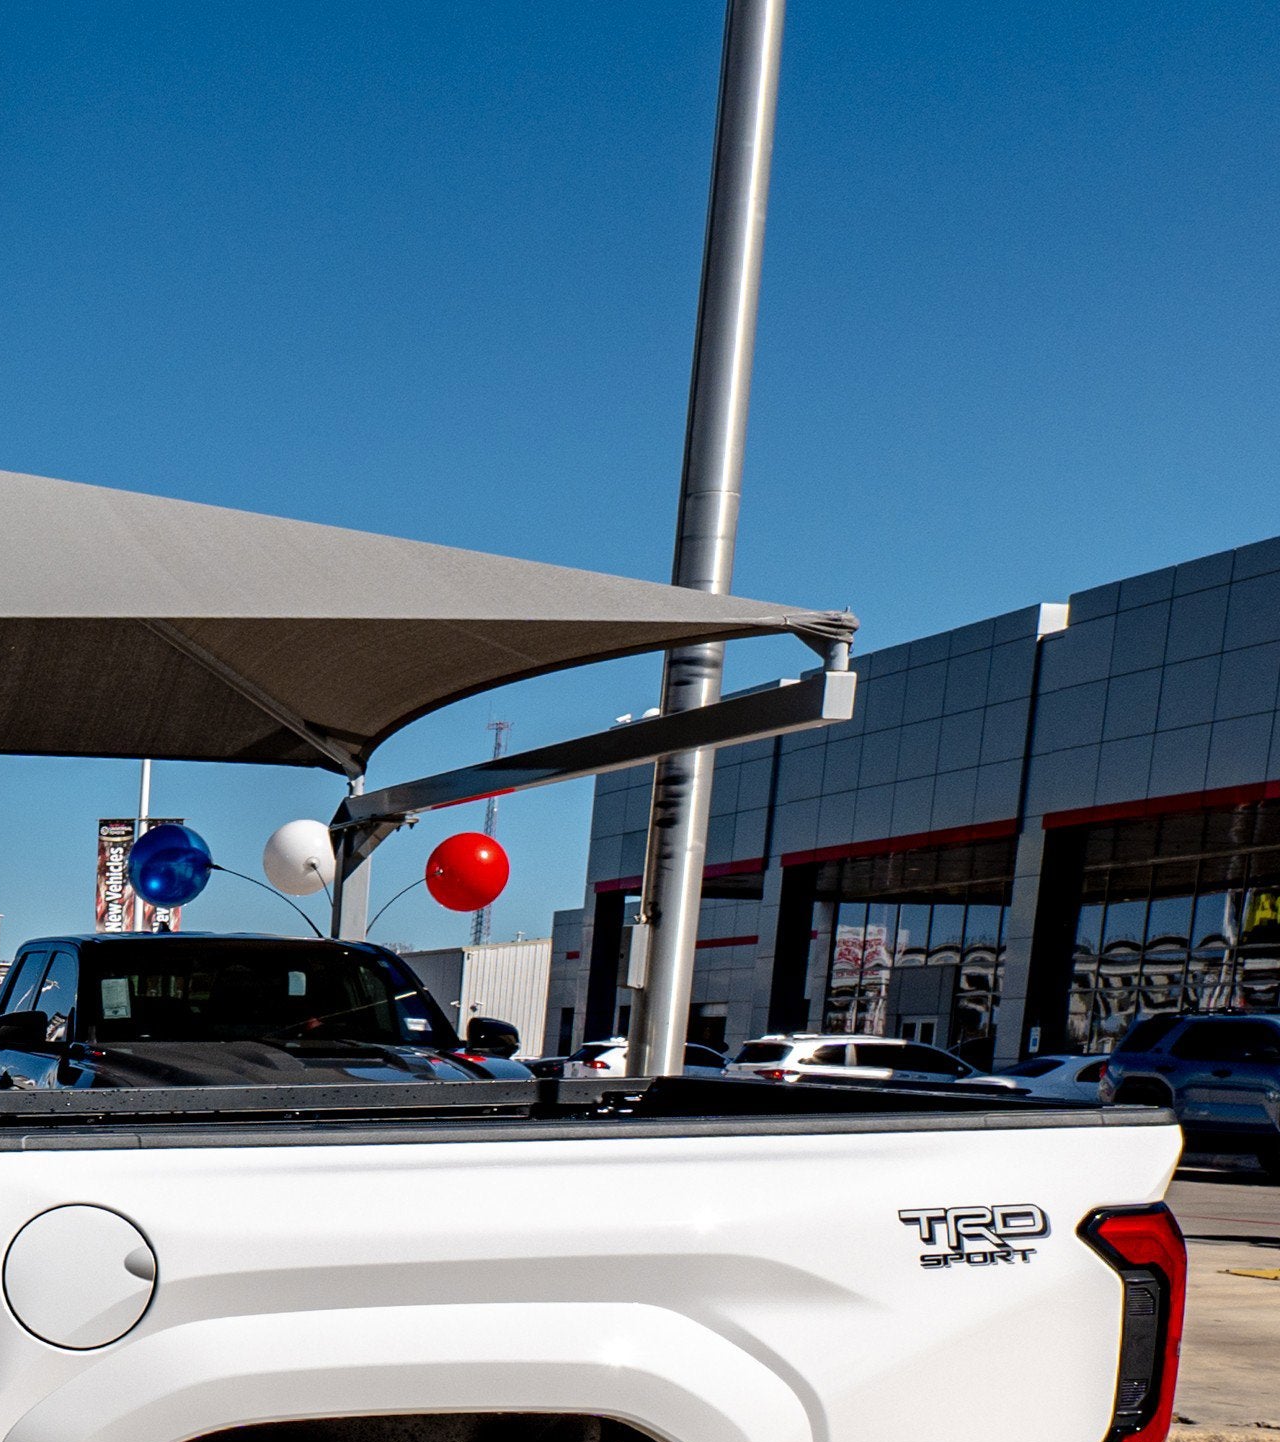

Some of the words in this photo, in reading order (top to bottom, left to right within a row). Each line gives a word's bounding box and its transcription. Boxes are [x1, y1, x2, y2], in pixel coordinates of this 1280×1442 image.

[105, 847, 124, 901] Vehicles
[105, 904, 122, 932] New
[898, 1203, 1049, 1251] TRD
[920, 1249, 1037, 1268] SPORT
